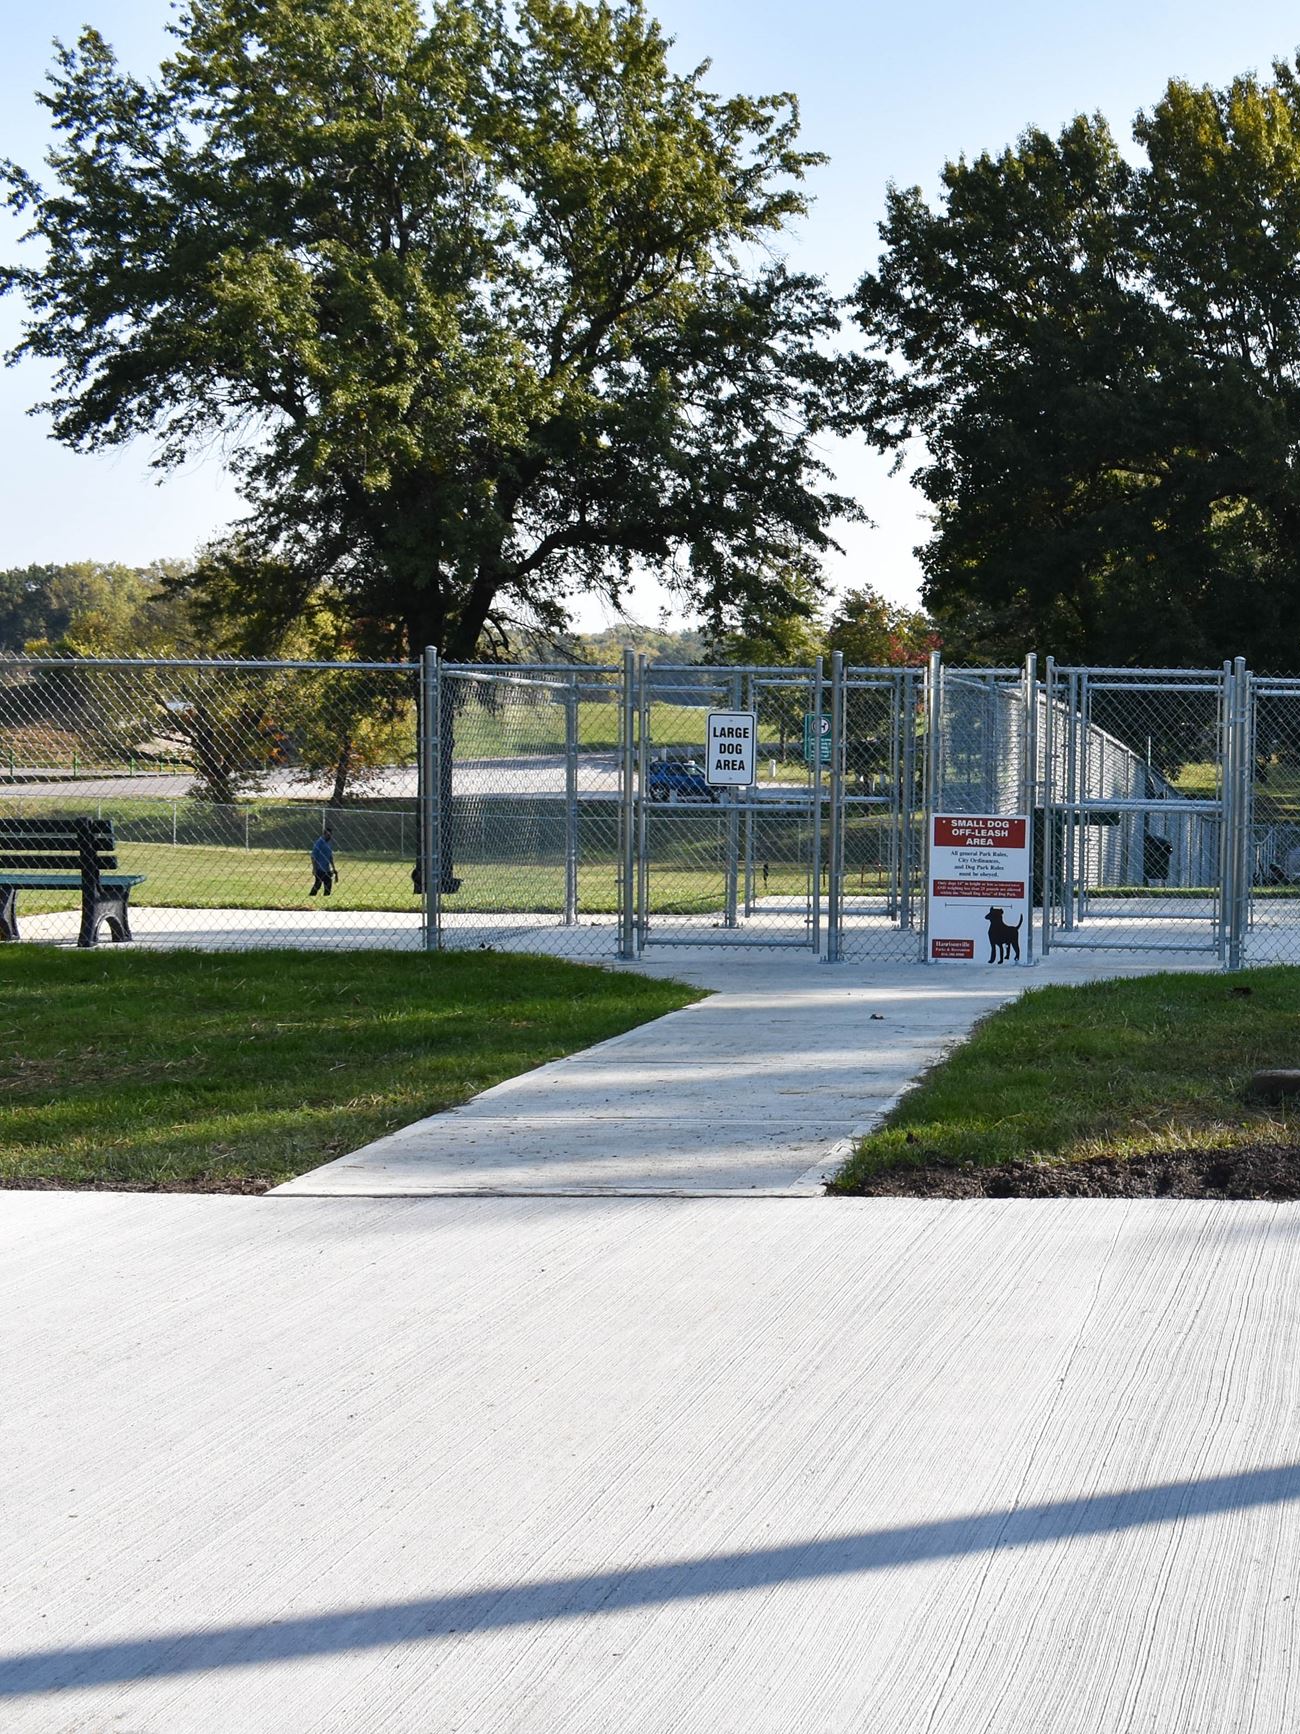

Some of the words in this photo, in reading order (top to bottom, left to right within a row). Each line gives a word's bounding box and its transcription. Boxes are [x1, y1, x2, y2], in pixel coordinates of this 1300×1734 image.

[713, 727, 749, 738] LARGE
[719, 744, 742, 754] DOG
[716, 760, 745, 770] AREA
